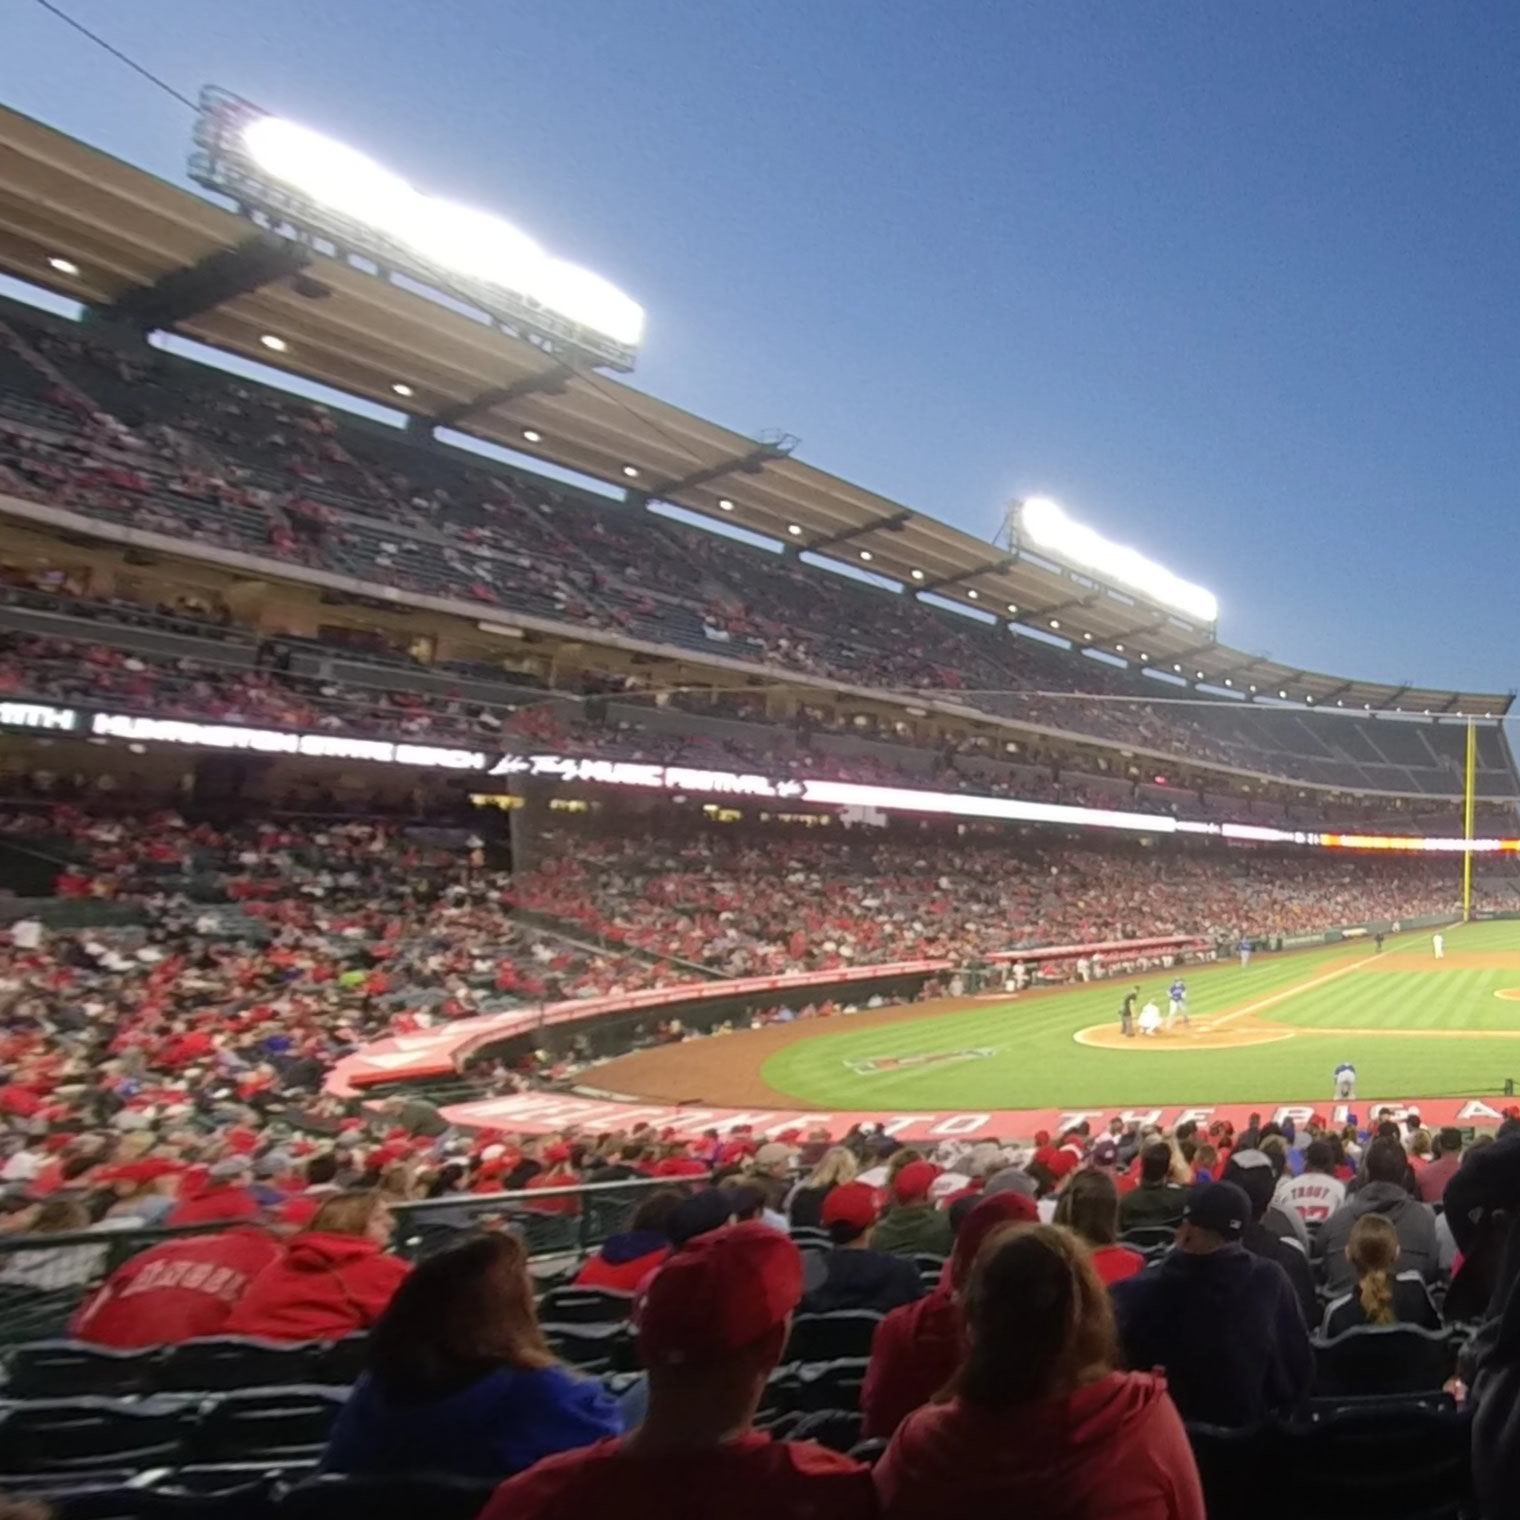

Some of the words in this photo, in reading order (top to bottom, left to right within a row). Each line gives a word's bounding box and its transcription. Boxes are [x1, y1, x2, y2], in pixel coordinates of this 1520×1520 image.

[460, 1096, 832, 1136] WELCOME
[884, 1113, 990, 1137] TO
[1057, 1107, 1216, 1133] THE
[1269, 1103, 1418, 1130] BIG
[1456, 1100, 1506, 1121] A
